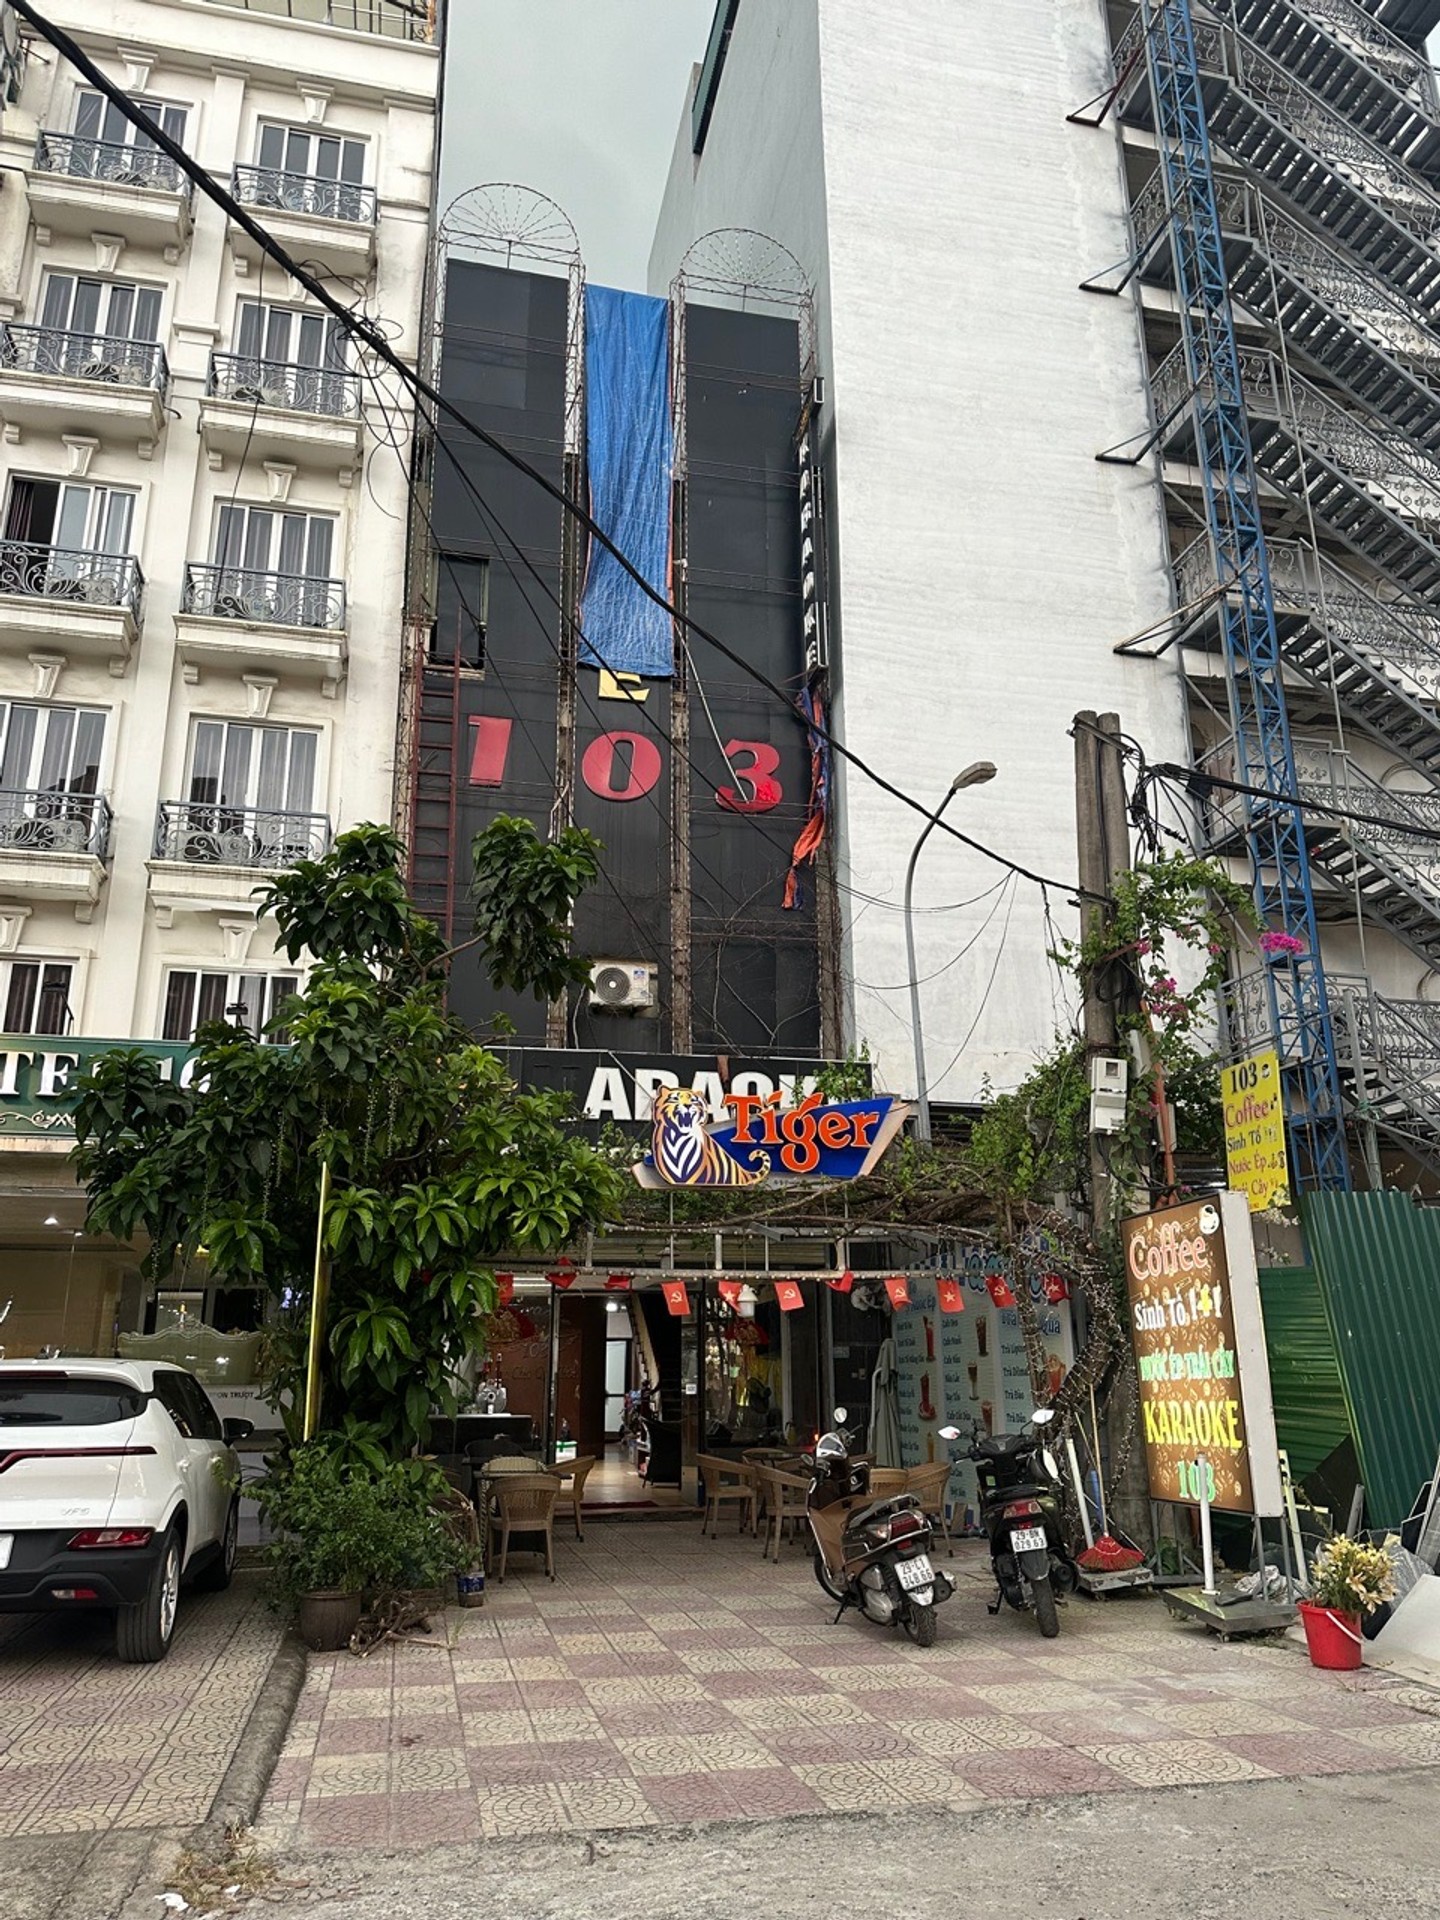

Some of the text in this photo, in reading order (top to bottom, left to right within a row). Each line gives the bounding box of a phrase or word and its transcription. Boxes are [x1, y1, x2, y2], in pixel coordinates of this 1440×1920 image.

[0, 1052, 106, 1096] TE
[1231, 1062, 1257, 1094] 103
[1225, 1094, 1269, 1128] Coffee
[723, 1091, 881, 1173] Tiger
[1227, 1133, 1246, 1153] Sinh
[1129, 1221, 1209, 1281] Coffee
[1134, 1298, 1166, 1331] Sinh
[1143, 1400, 1243, 1449] KARAOKE
